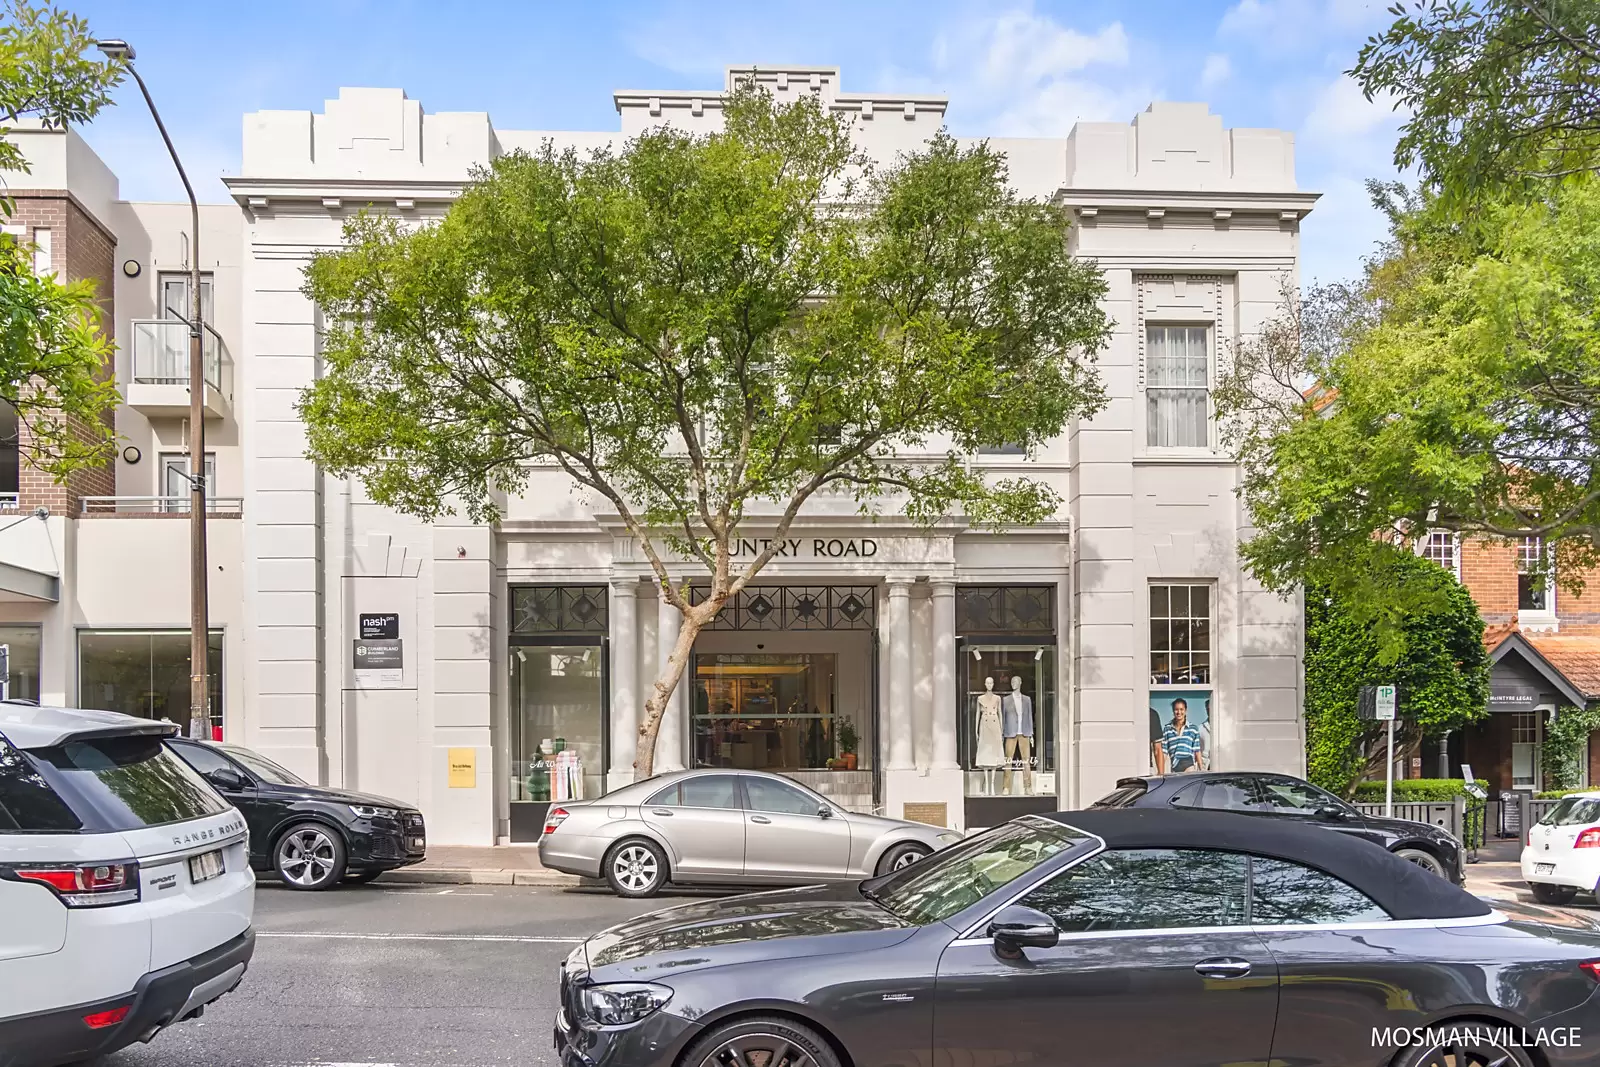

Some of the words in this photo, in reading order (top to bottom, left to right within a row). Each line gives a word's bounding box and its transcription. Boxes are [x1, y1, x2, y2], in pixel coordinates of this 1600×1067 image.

[813, 539, 878, 557] ROAD
[363, 617, 387, 626] nash
[1379, 687, 1393, 698] 1P
[171, 828, 215, 845] RANGE
[218, 820, 243, 835] ROVER
[149, 873, 177, 886] SPORT
